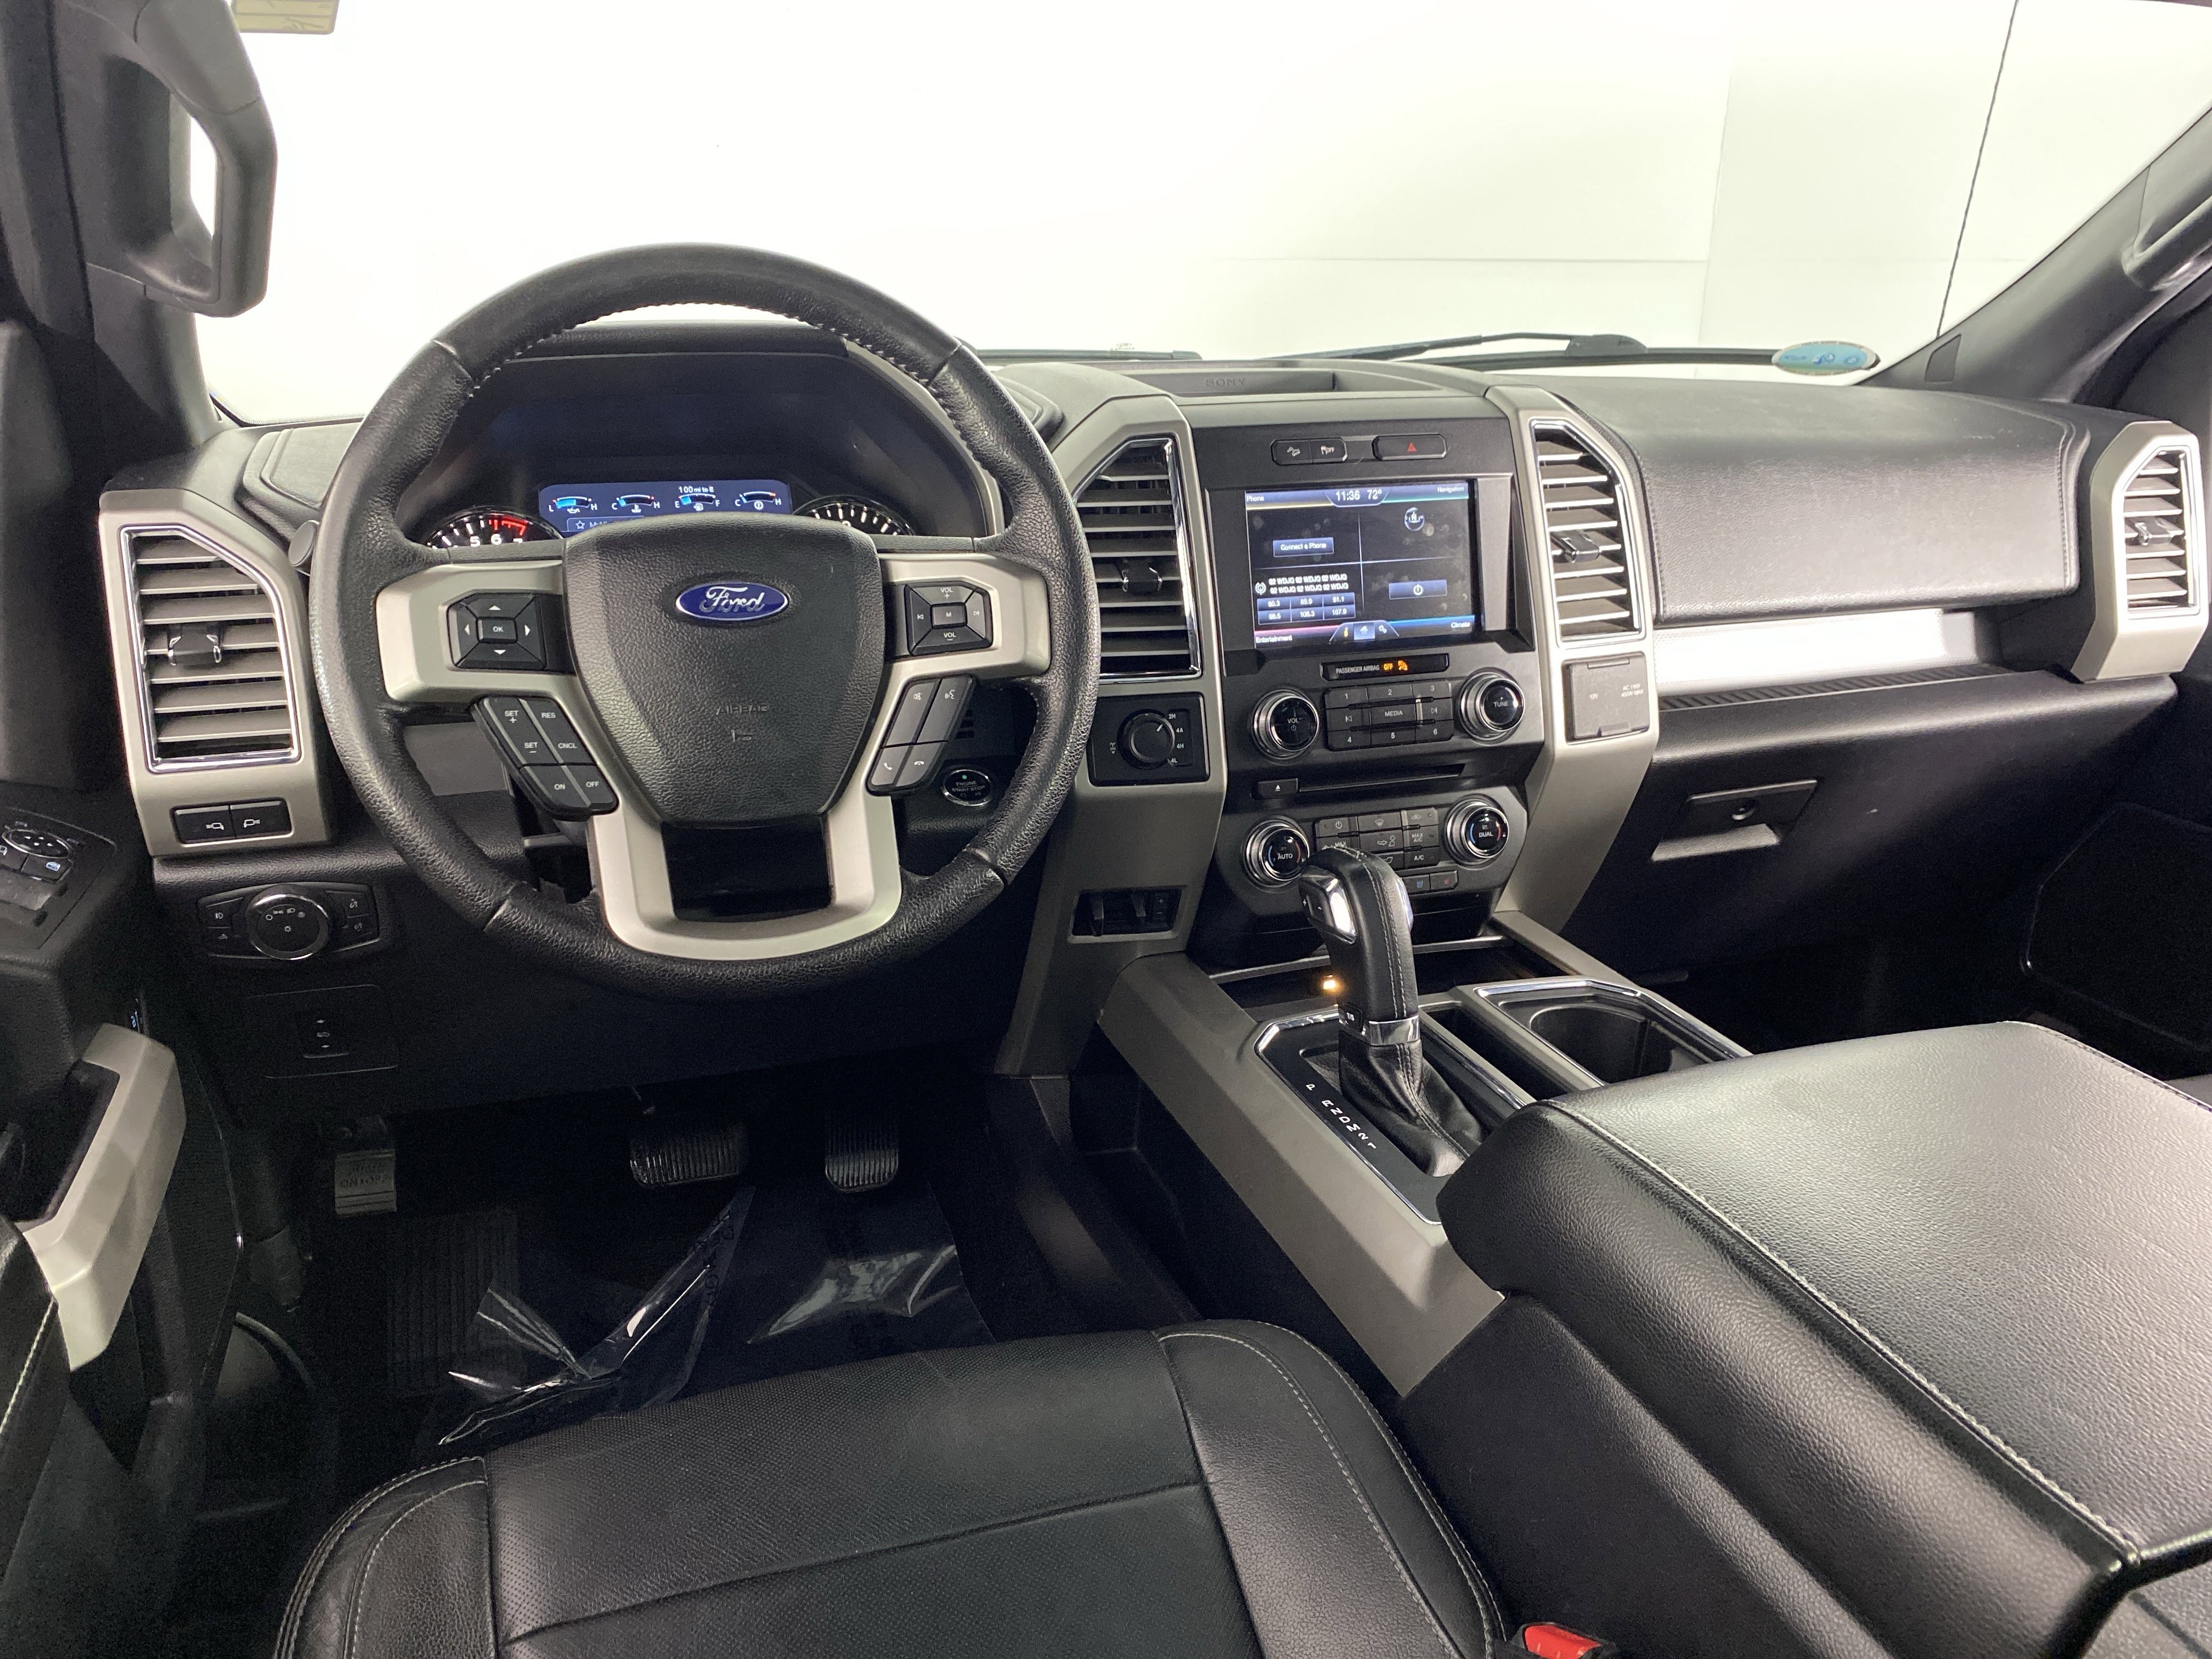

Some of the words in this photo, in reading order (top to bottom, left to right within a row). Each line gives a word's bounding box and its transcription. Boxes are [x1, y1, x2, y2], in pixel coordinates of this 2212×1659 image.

[1206, 379, 1246, 387] SONY
[1336, 490, 1360, 500] 11:36
[470, 536, 481, 547] 5
[490, 533, 502, 545] 6
[699, 586, 765, 613] Ford
[1451, 620, 1470, 629] Climate
[1255, 635, 1293, 644] Entertainment
[1336, 666, 1363, 674] PASSENGER
[1346, 1123, 1361, 1132] M
